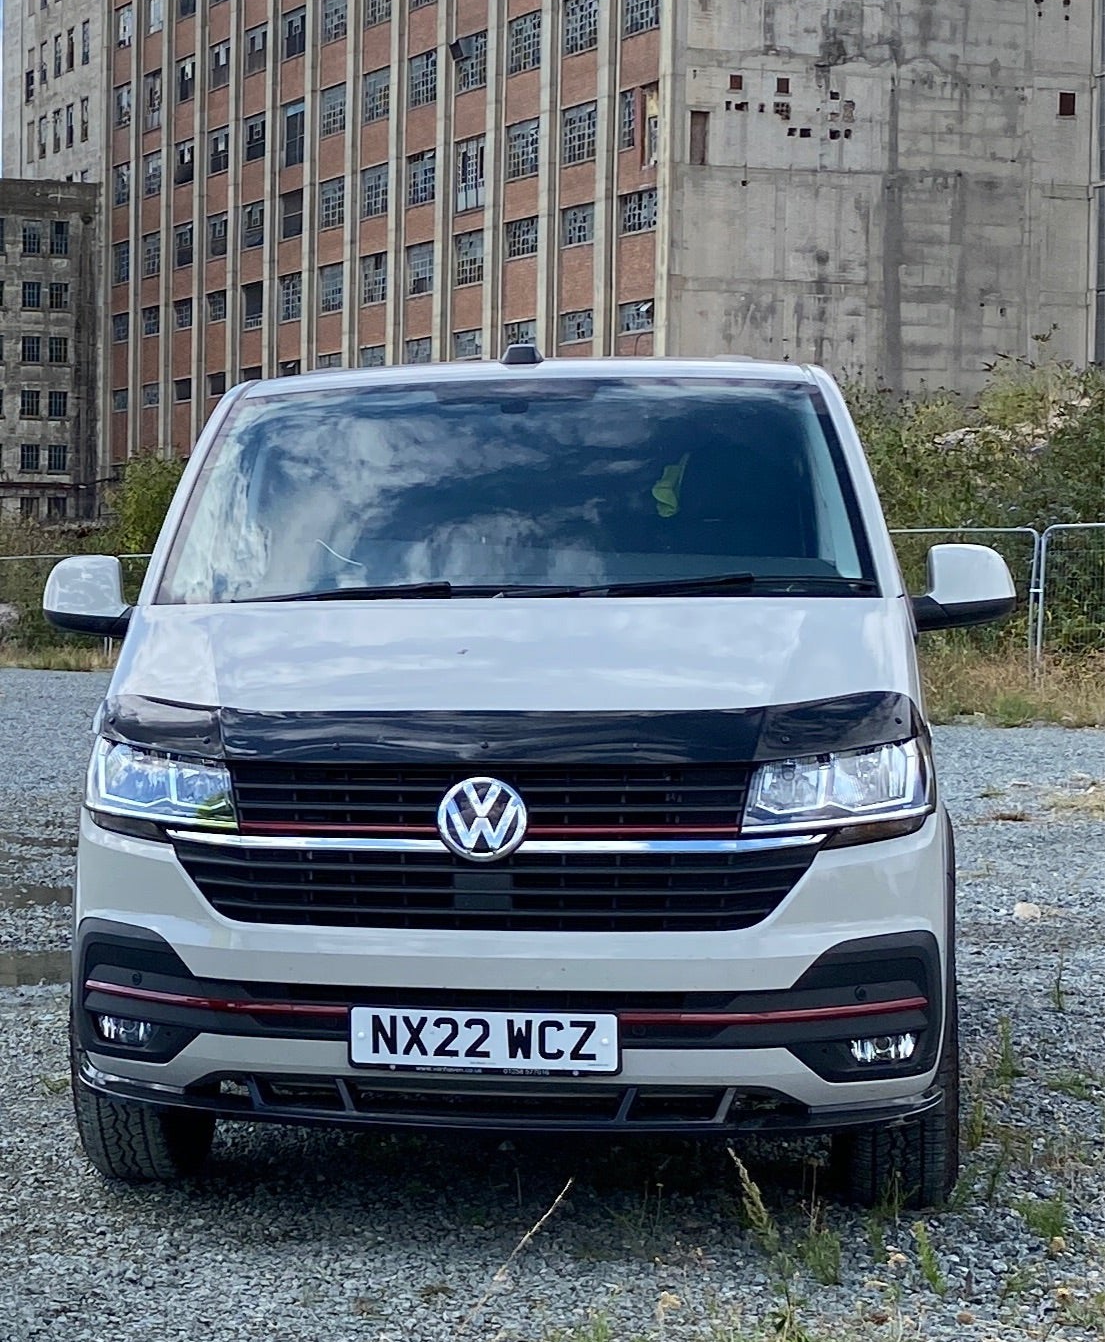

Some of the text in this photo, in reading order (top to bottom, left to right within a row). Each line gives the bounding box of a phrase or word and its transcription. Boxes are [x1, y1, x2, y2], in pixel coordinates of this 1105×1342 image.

[438, 776, 527, 862] VW
[371, 1014, 597, 1060] NX22 WCZ
